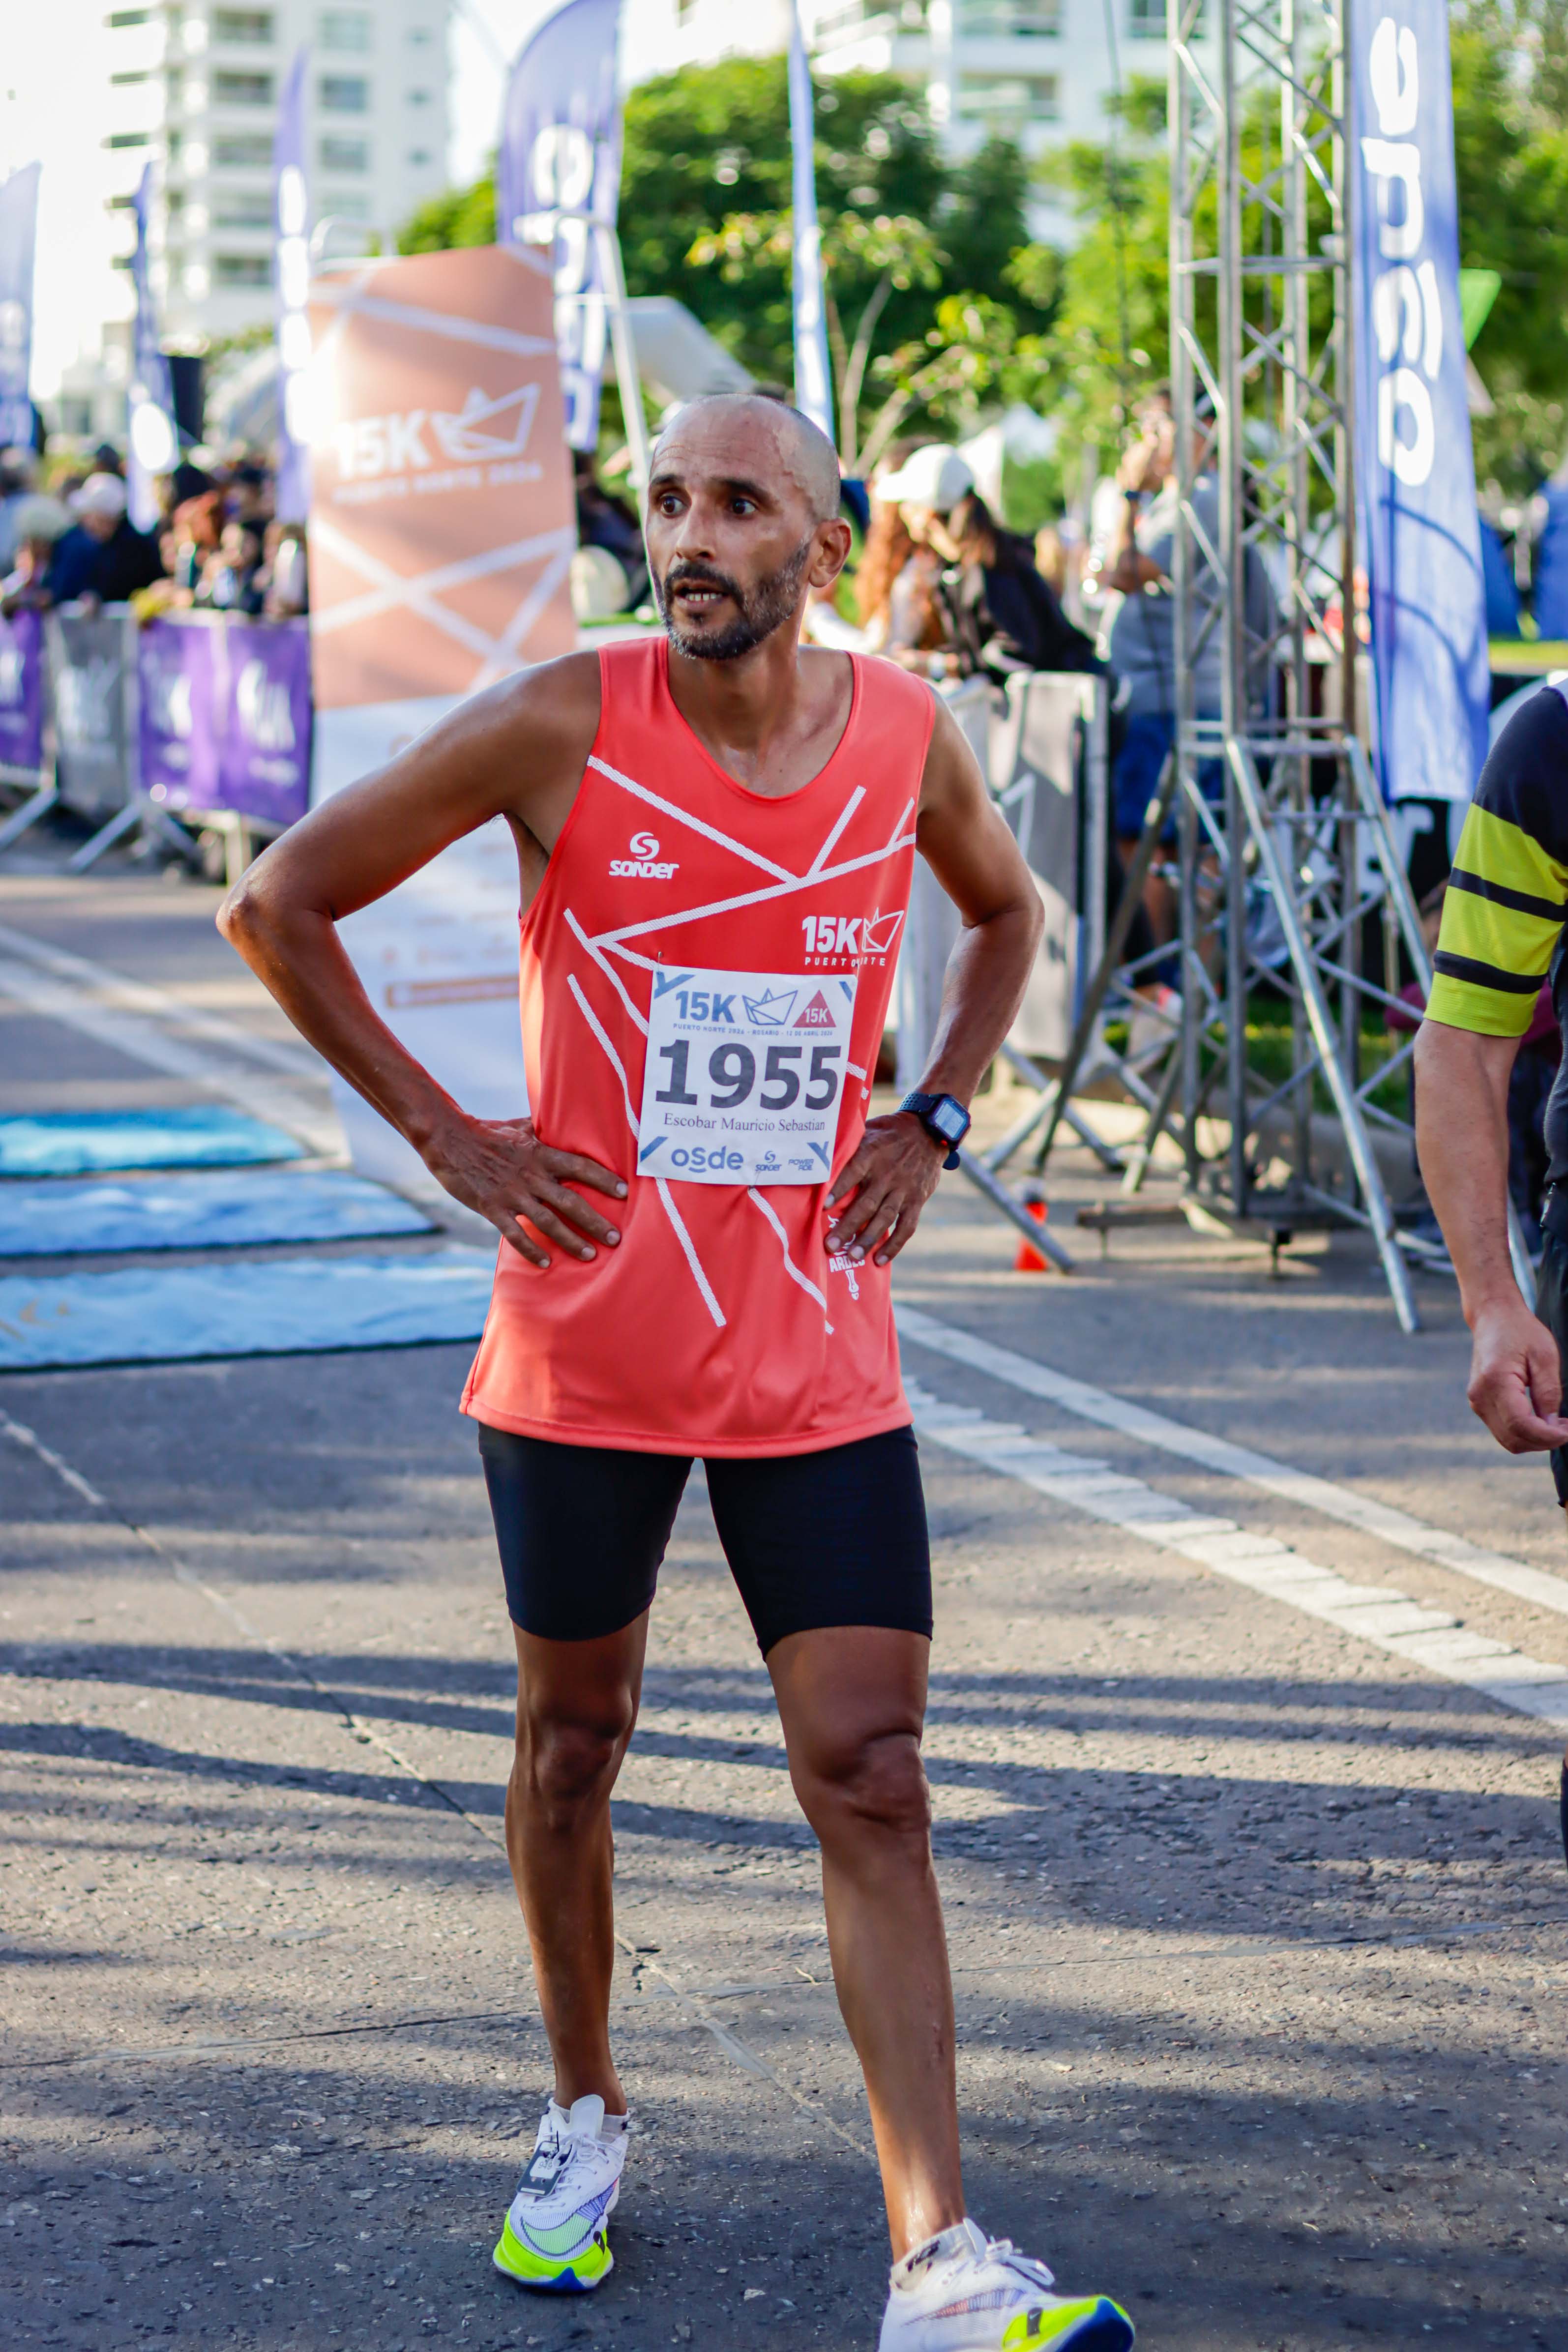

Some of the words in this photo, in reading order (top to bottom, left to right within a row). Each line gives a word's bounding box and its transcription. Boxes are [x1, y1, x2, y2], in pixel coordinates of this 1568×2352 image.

[1360, 17, 1440, 486] osde
[332, 409, 433, 480] 15K
[802, 916, 862, 954] 15K
[804, 957, 856, 968] PUERTO
[675, 990, 737, 1023] 15K
[803, 1008, 829, 1023] 15K
[655, 1039, 842, 1111] 1955
[664, 1113, 716, 1129] Escobar
[721, 1117, 774, 1131] Mauricio
[778, 1118, 825, 1131] Sebastian
[671, 1146, 743, 1172] osde
